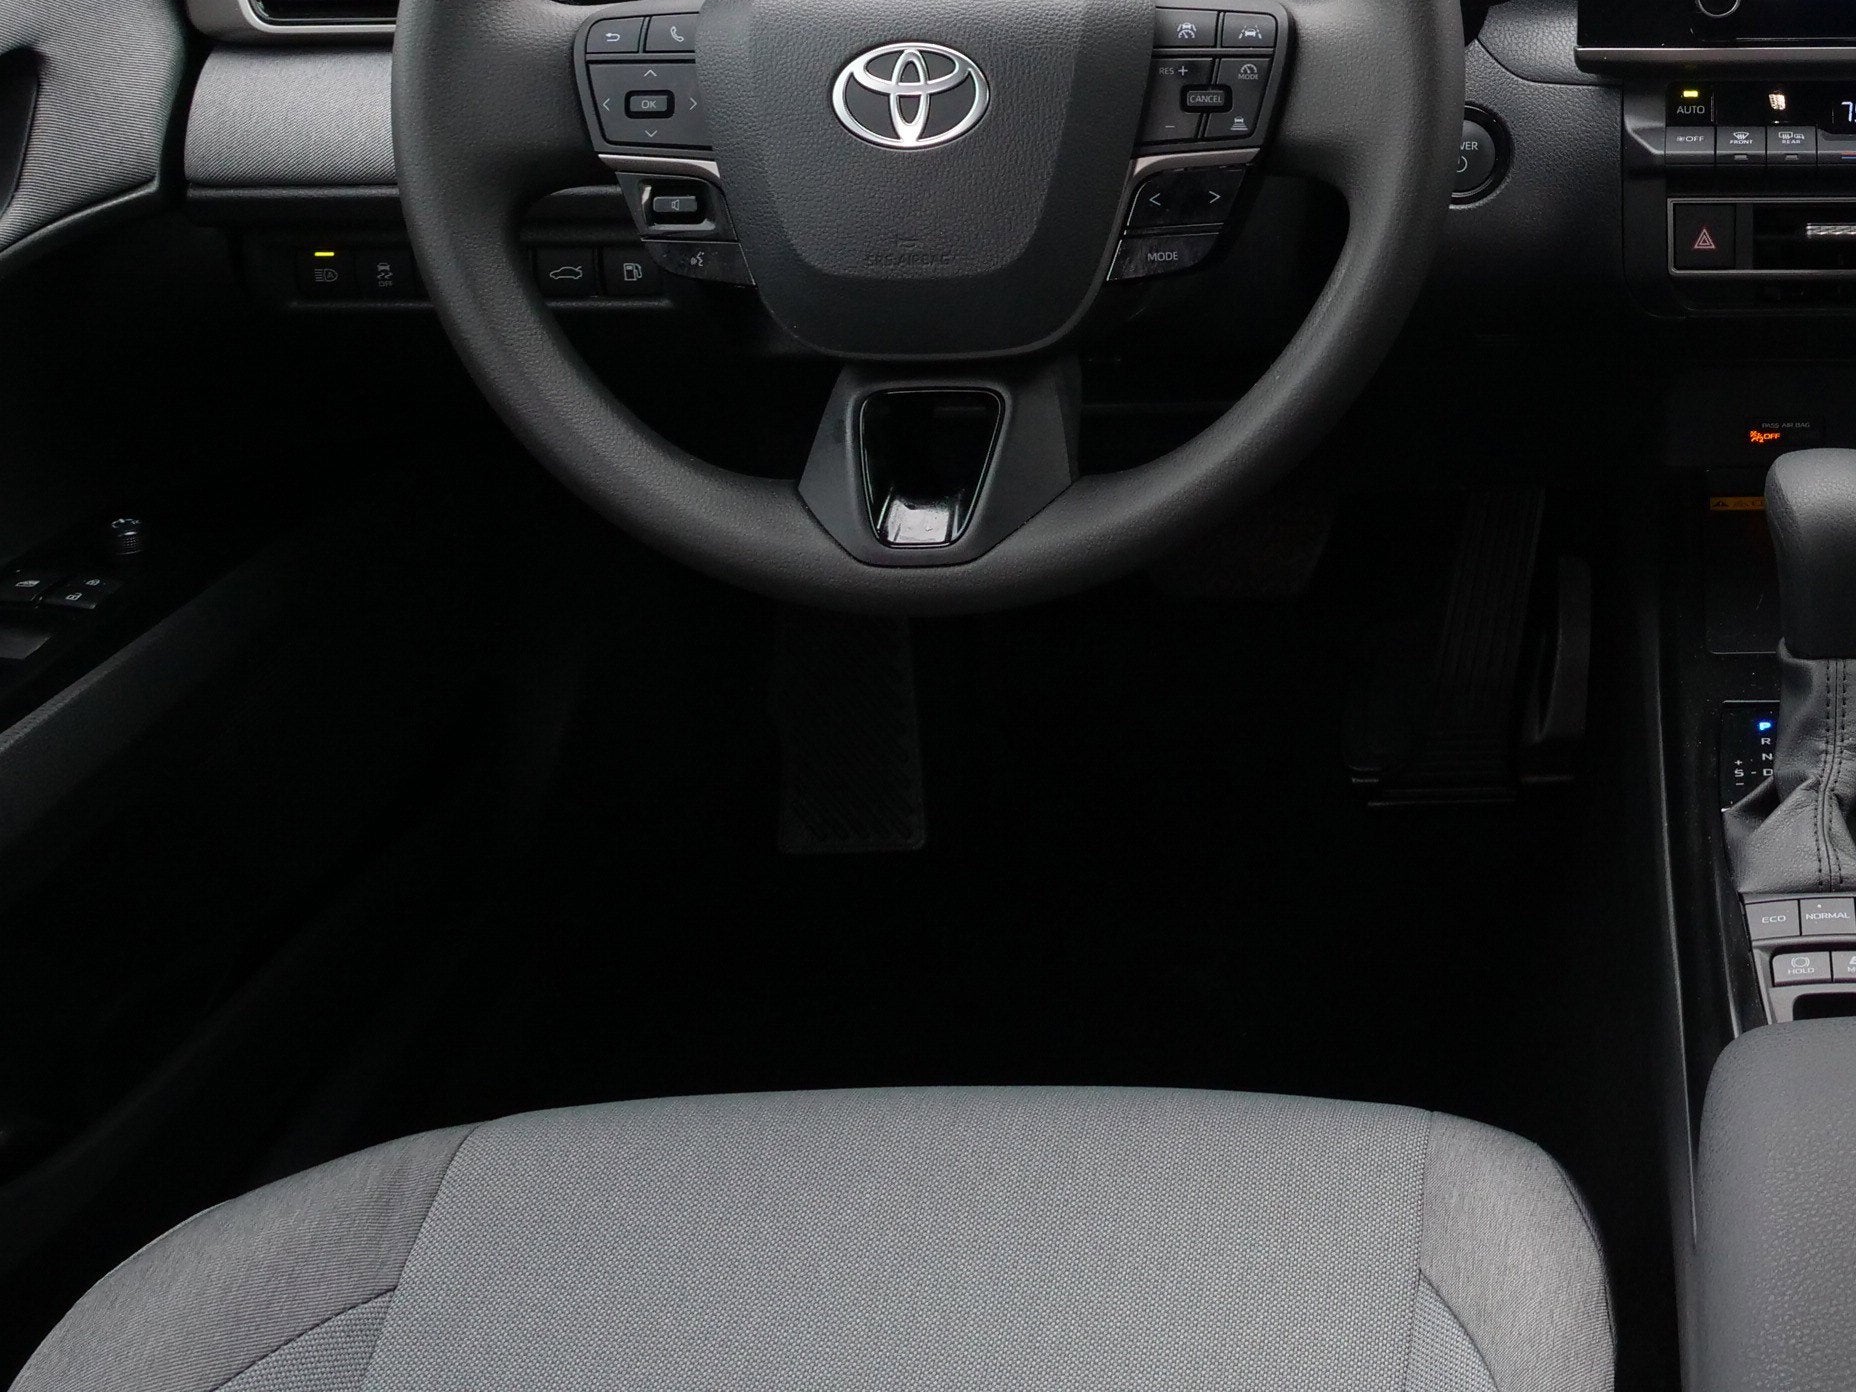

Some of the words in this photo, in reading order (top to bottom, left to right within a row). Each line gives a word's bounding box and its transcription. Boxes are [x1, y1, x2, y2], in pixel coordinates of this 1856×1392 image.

[1158, 66, 1175, 75] RES
[1238, 72, 1260, 81] MODE
[1189, 93, 1223, 104] CANCEL
[640, 98, 657, 109] OK
[1676, 105, 1705, 115] AUTO
[1147, 250, 1179, 261] MODE
[1759, 721, 1771, 730] P
[1761, 737, 1771, 745] R
[1735, 769, 1744, 777] S
[1762, 915, 1787, 923] ECO
[1805, 911, 1850, 920] NORMAL
[1788, 967, 1815, 975] HOLD
